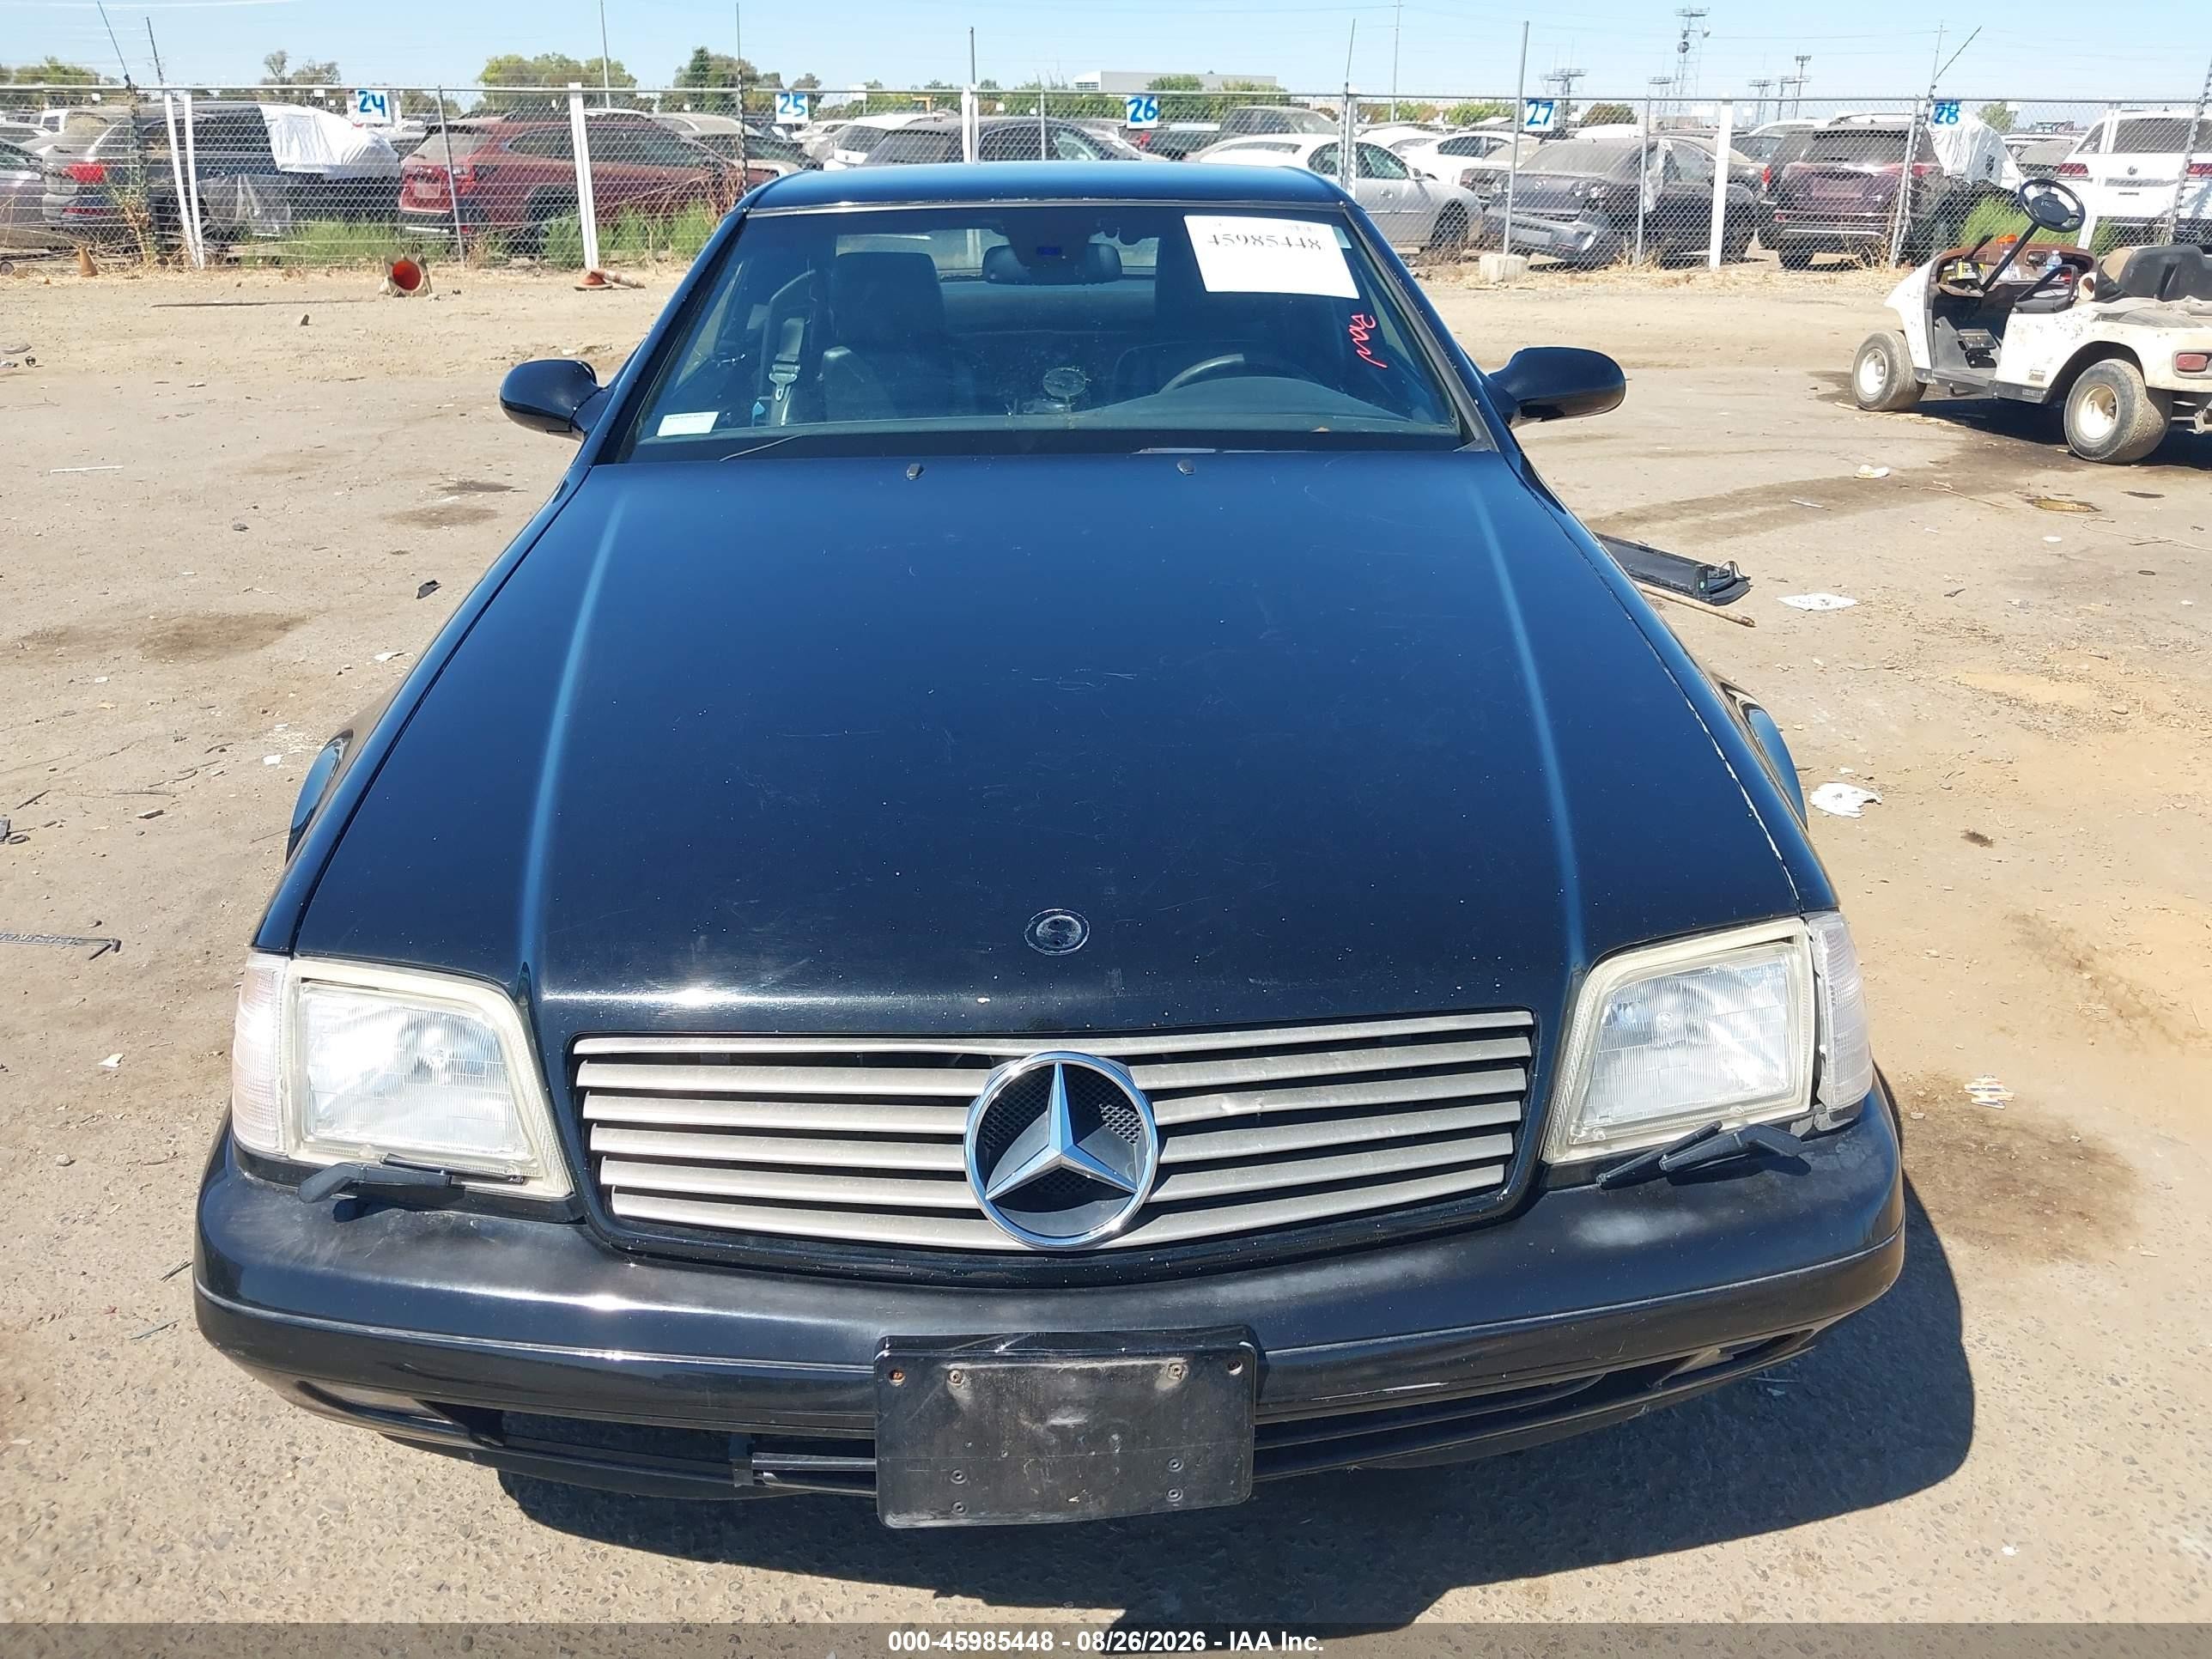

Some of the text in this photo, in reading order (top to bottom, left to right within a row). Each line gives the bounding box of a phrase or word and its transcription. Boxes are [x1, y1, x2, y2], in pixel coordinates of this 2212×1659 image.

[358, 90, 386, 117] 24
[779, 93, 805, 117] 25
[1127, 96, 1158, 122] 26
[1527, 100, 1553, 125] 27
[1934, 100, 1960, 125] 28
[1207, 233, 1322, 251] 45985448
